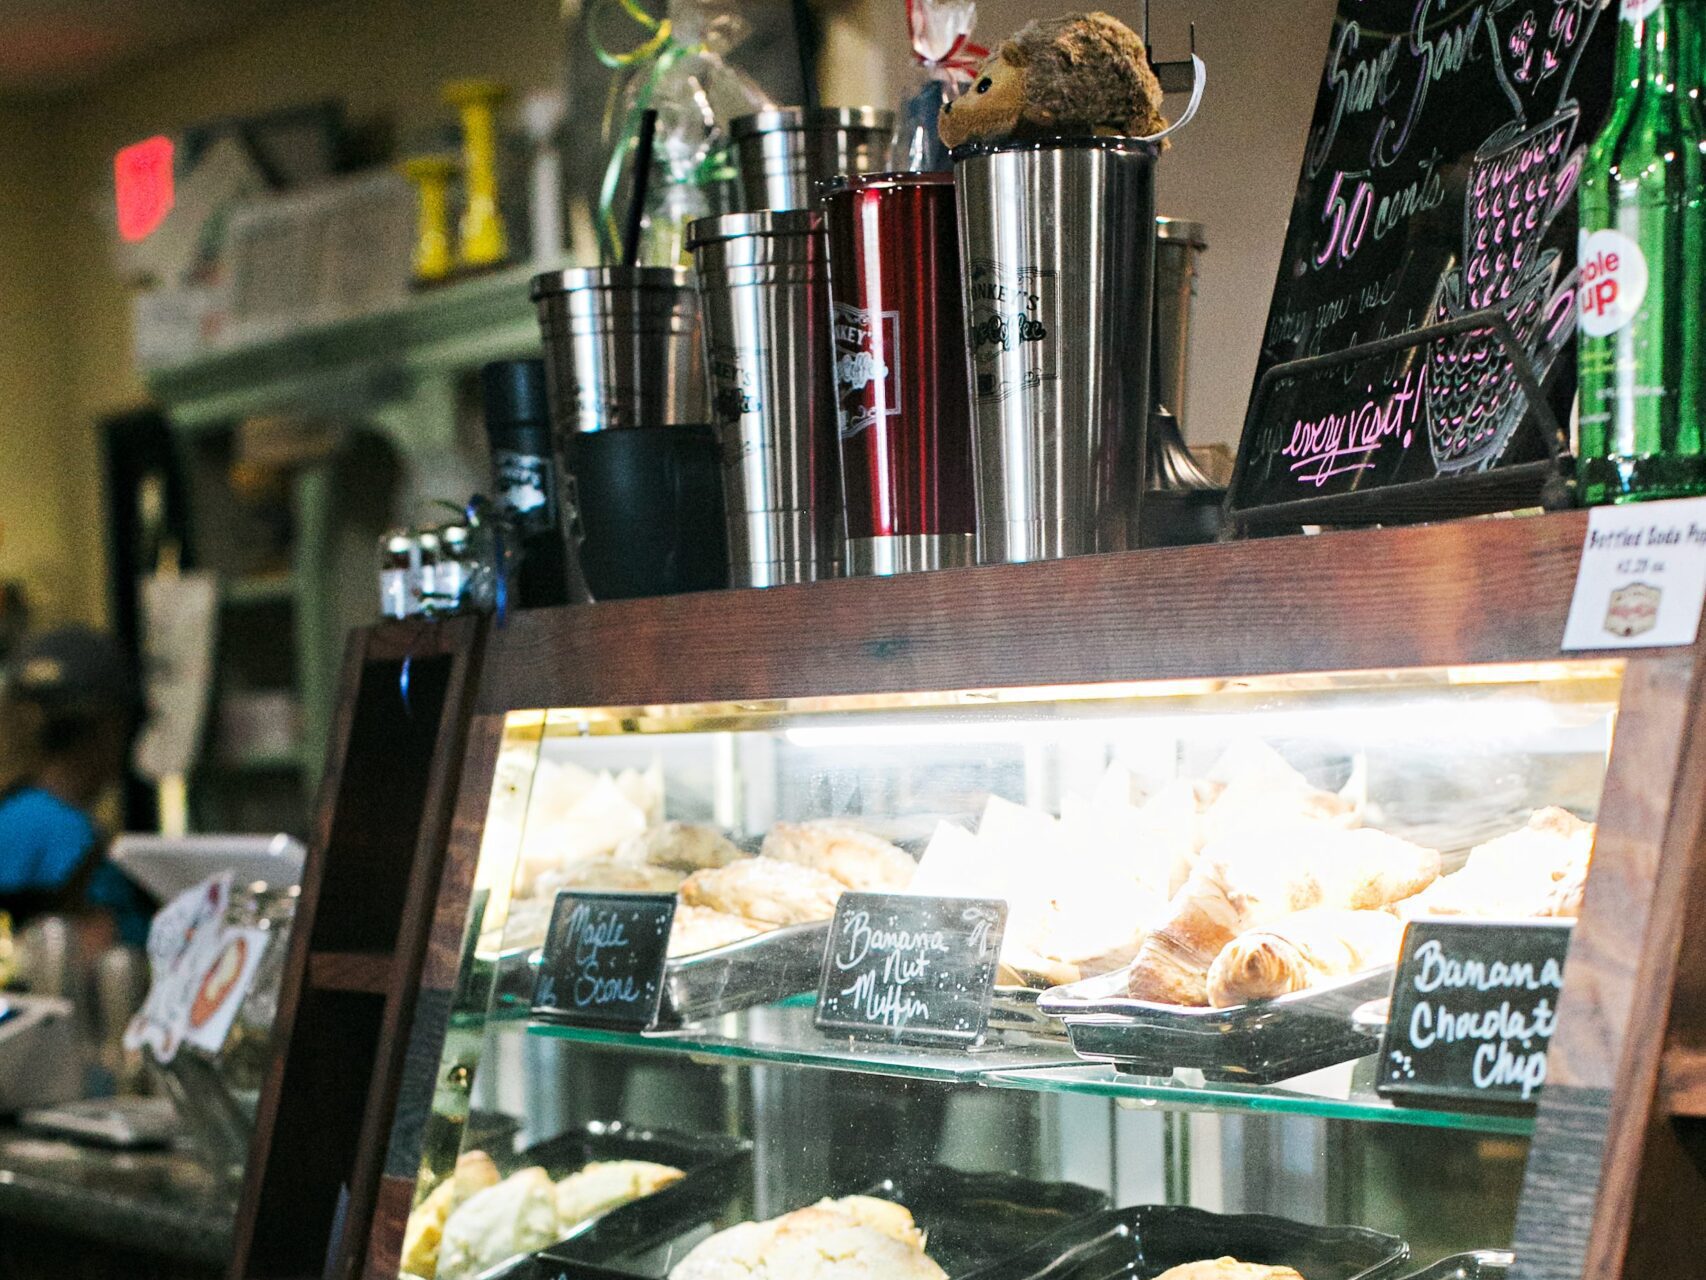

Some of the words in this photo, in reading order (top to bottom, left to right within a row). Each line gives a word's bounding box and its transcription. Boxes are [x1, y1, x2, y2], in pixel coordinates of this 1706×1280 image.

[1311, 169, 1375, 271] 50
[1374, 147, 1445, 241] cents
[1581, 278, 1619, 317] up
[1282, 414, 1348, 487] every
[1349, 364, 1428, 449] visit!
[565, 903, 629, 966] Maple
[836, 911, 950, 971] Banana
[574, 960, 641, 1007] Scone
[883, 948, 931, 985] Nut
[1413, 939, 1564, 993] Banana
[841, 969, 930, 1027] Muffin
[1472, 1041, 1548, 1100] Chip
